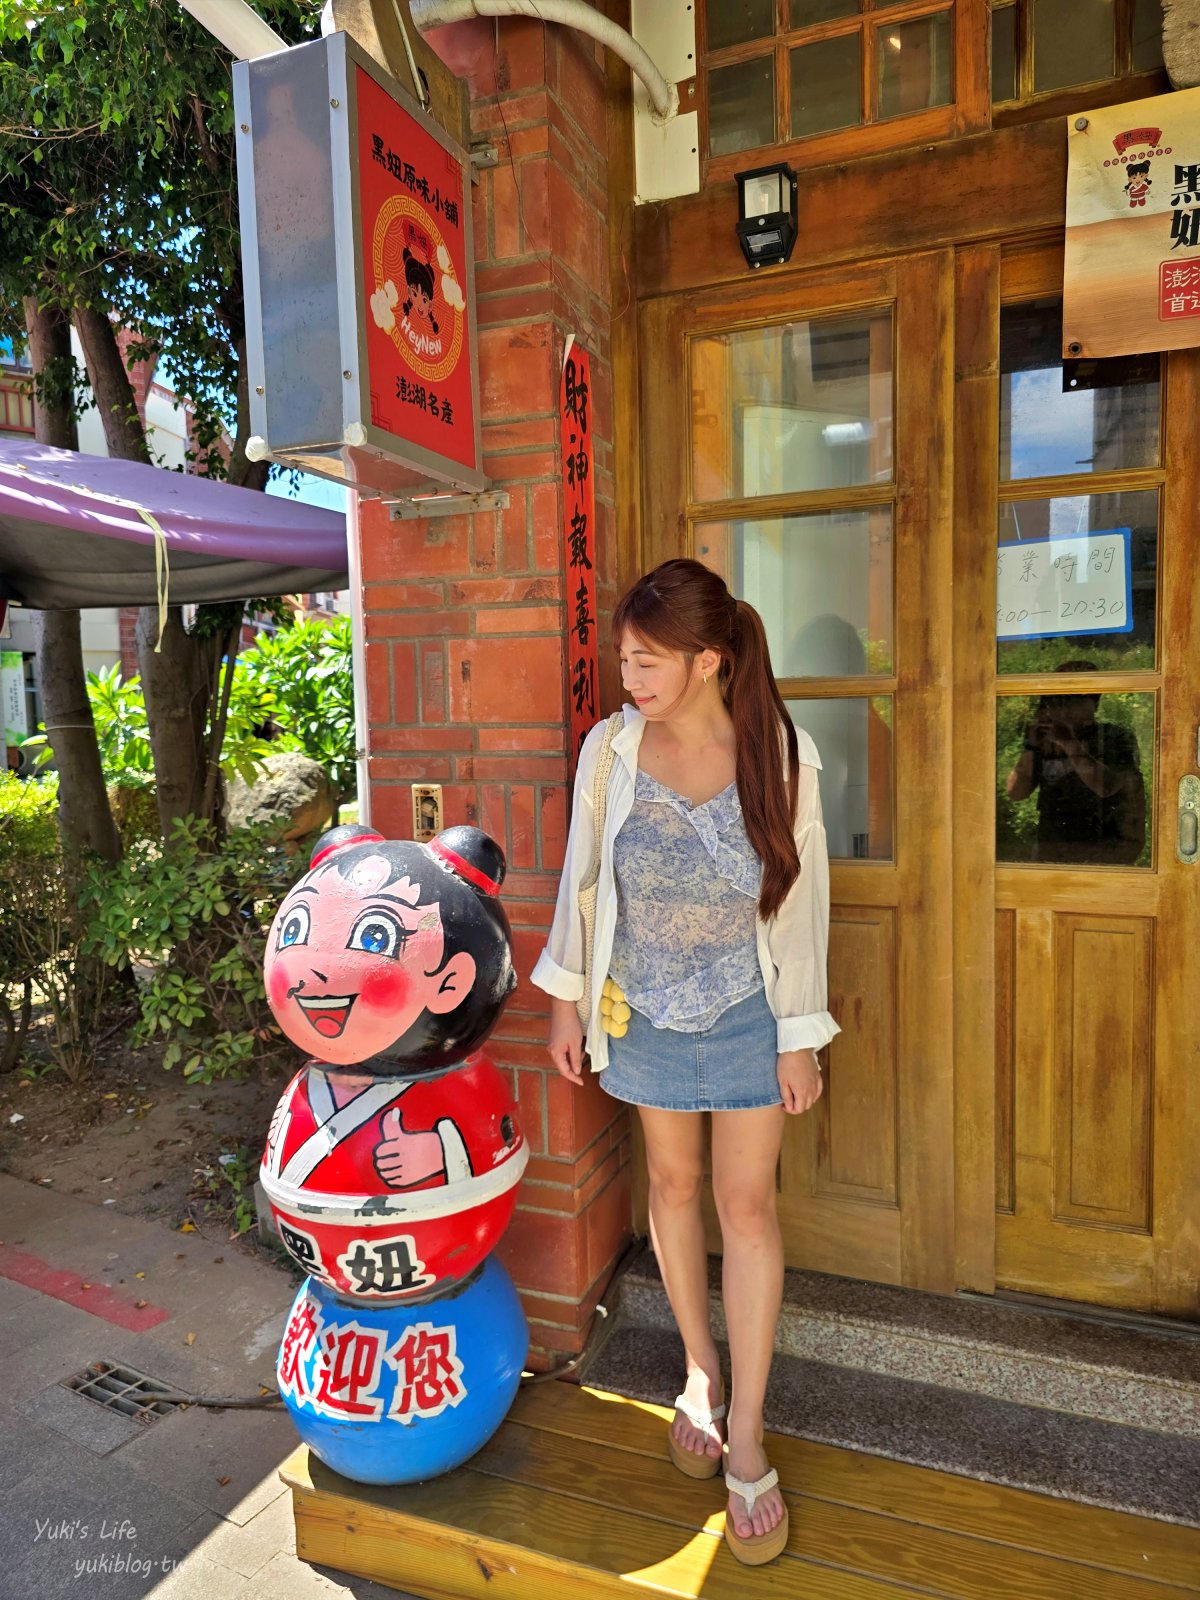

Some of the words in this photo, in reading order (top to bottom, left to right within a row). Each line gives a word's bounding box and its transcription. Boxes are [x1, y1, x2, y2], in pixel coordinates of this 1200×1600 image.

[400, 316, 442, 355] HeyNew
[280, 1223, 427, 1293] 黑妞
[279, 1298, 460, 1415] 歡迎您
